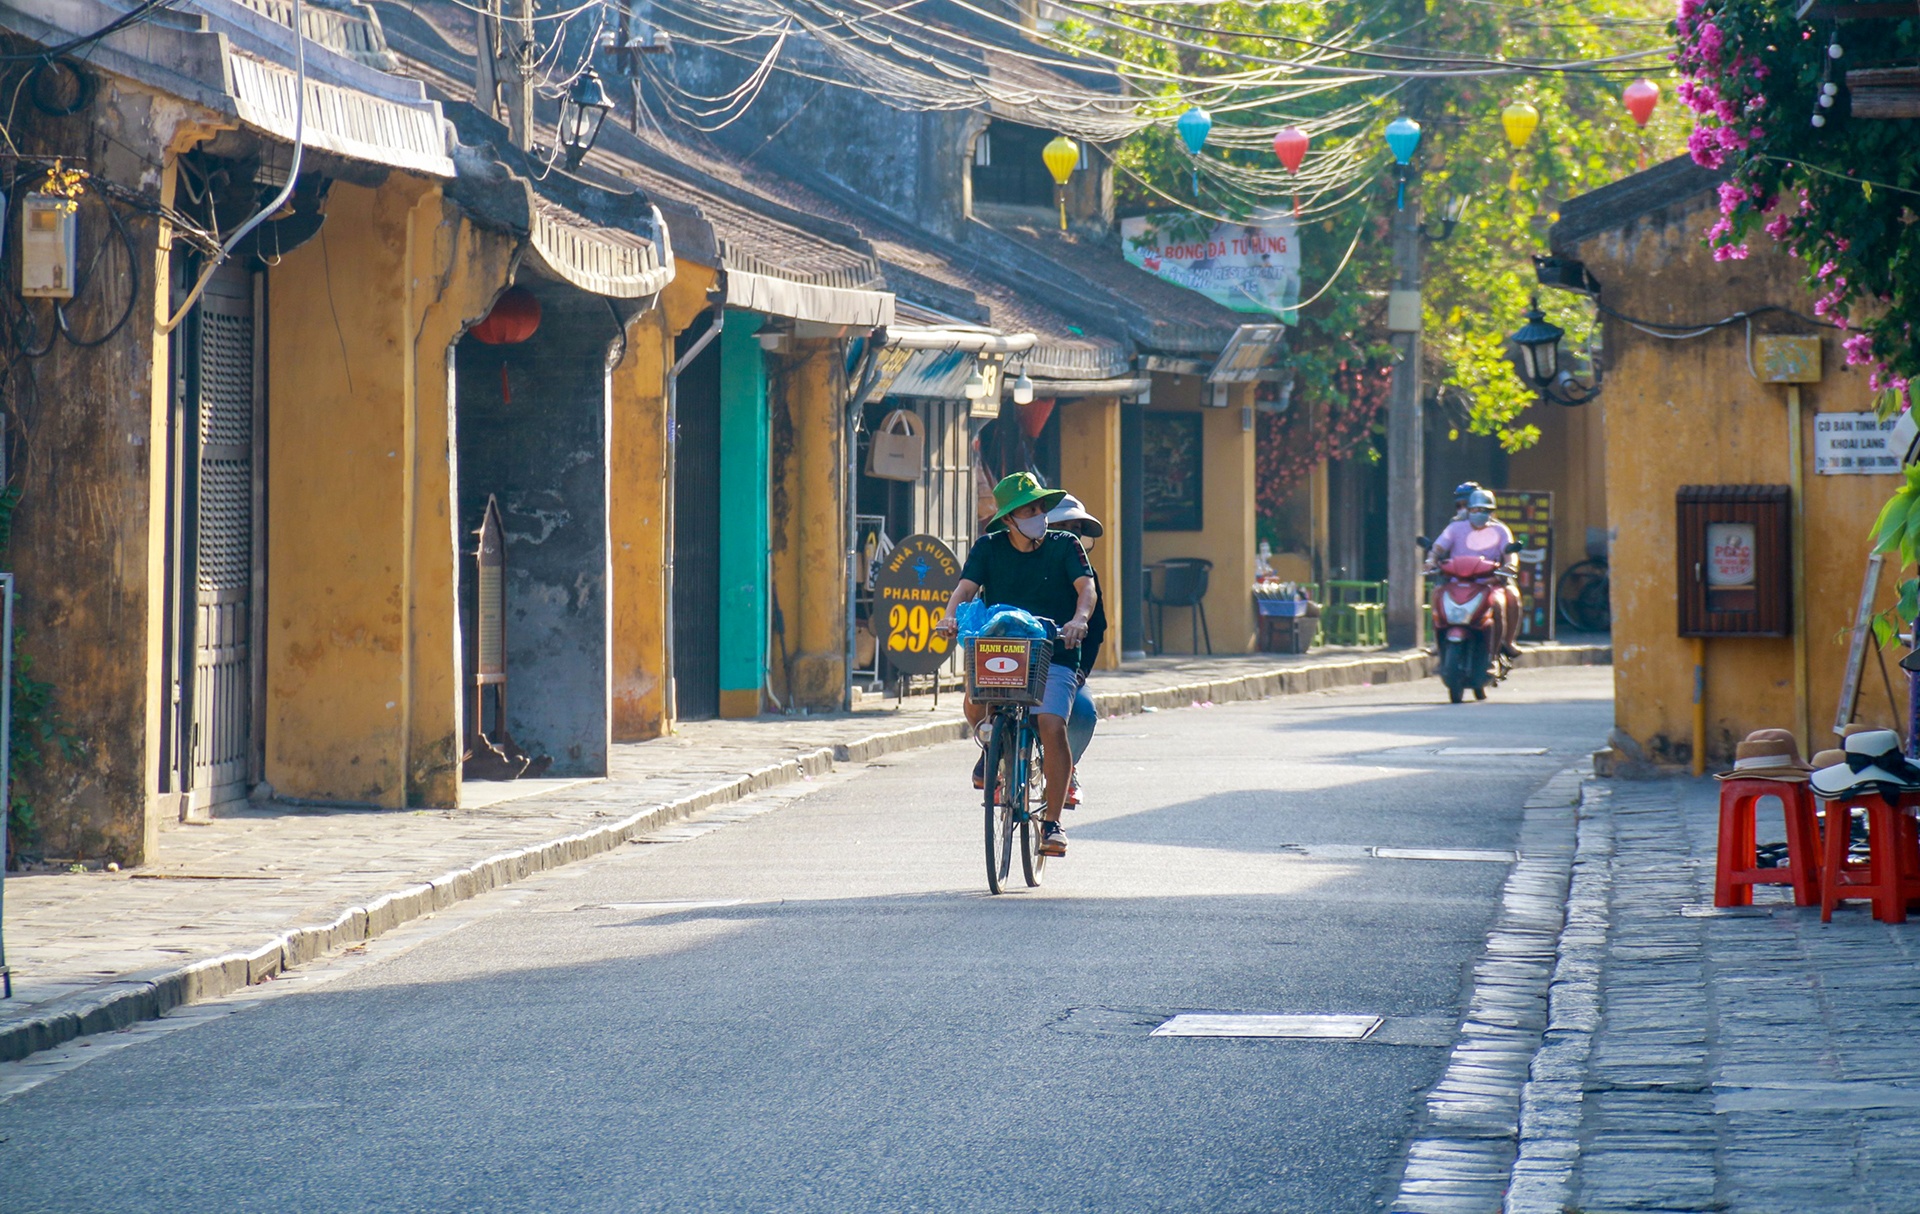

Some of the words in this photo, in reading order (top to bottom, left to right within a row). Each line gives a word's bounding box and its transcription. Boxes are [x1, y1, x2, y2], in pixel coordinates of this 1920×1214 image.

[1830, 438, 1859, 449] KHOAI
[1860, 438, 1885, 449] LANG
[916, 541, 955, 576] THUỐC
[883, 587, 954, 602] PHARMAC
[887, 603, 949, 654] 292
[979, 644, 1001, 654] HẠNH
[1003, 645, 1026, 654] GAME
[999, 660, 1005, 669] 1
